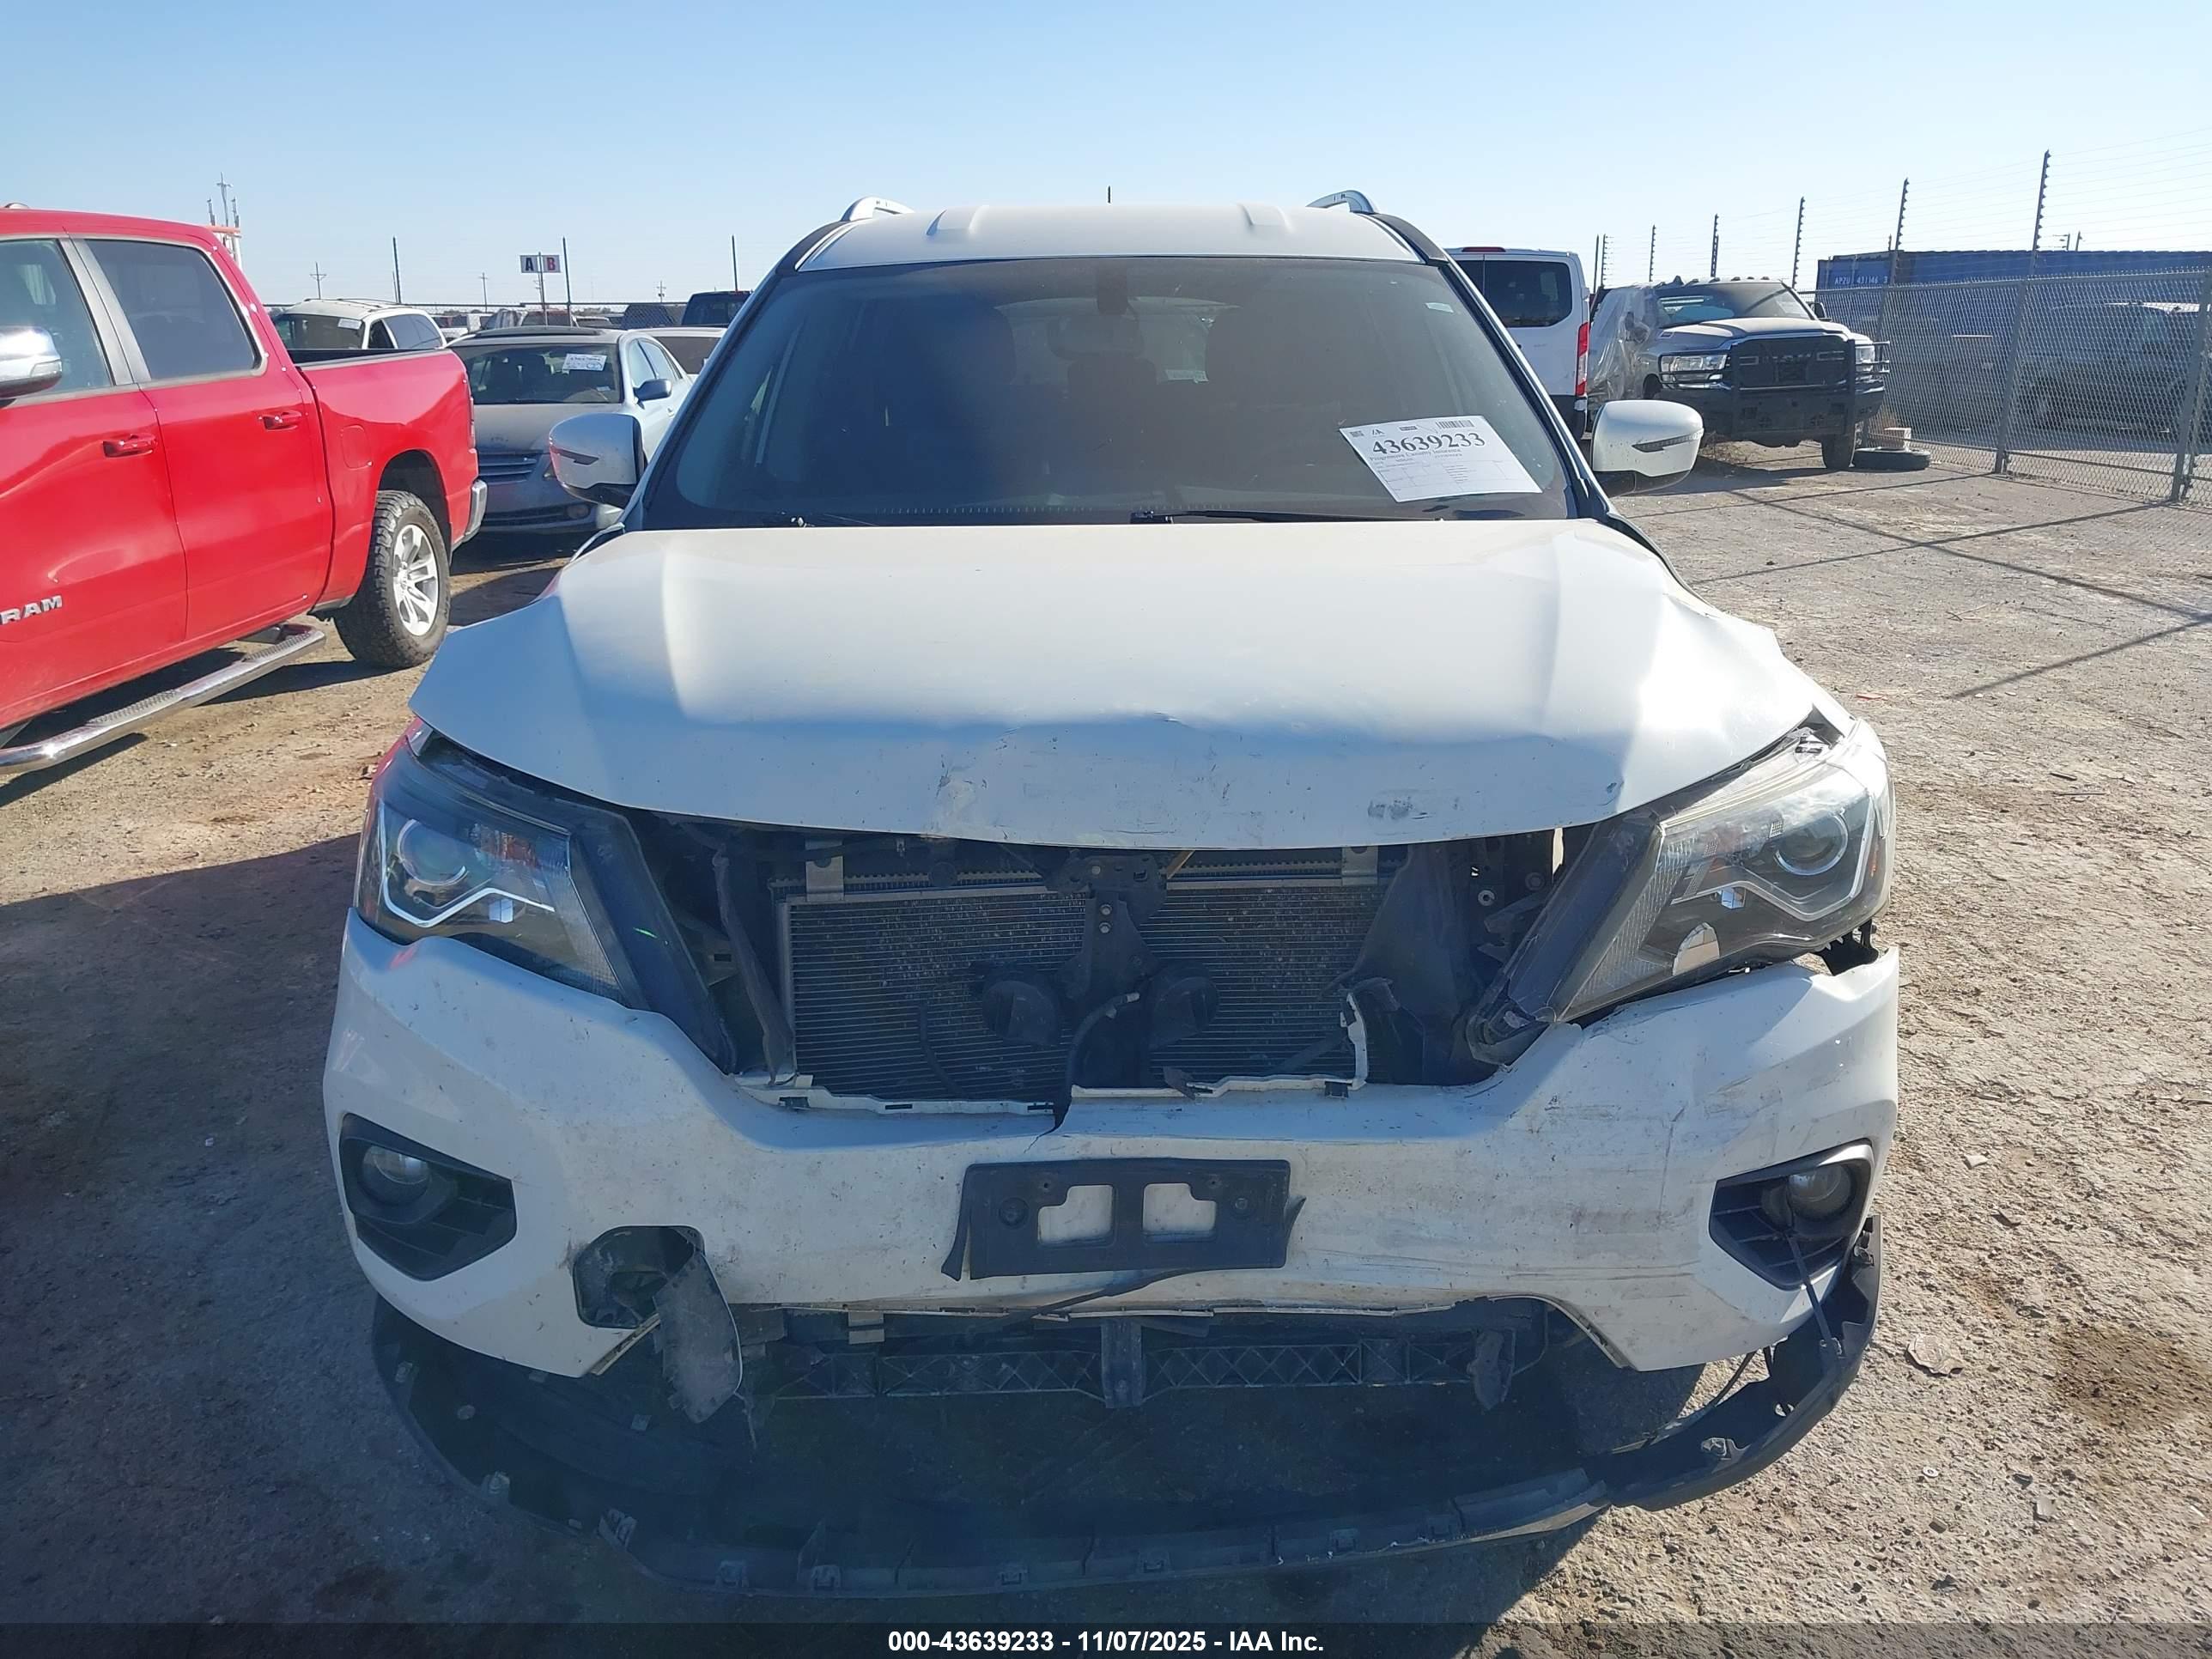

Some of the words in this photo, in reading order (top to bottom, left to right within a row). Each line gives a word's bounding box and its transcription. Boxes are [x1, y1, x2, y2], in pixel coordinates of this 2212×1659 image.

[525, 257, 535, 271] A
[546, 257, 556, 271] B
[1372, 432, 1486, 454] 43639233
[0, 594, 63, 626] RAM
